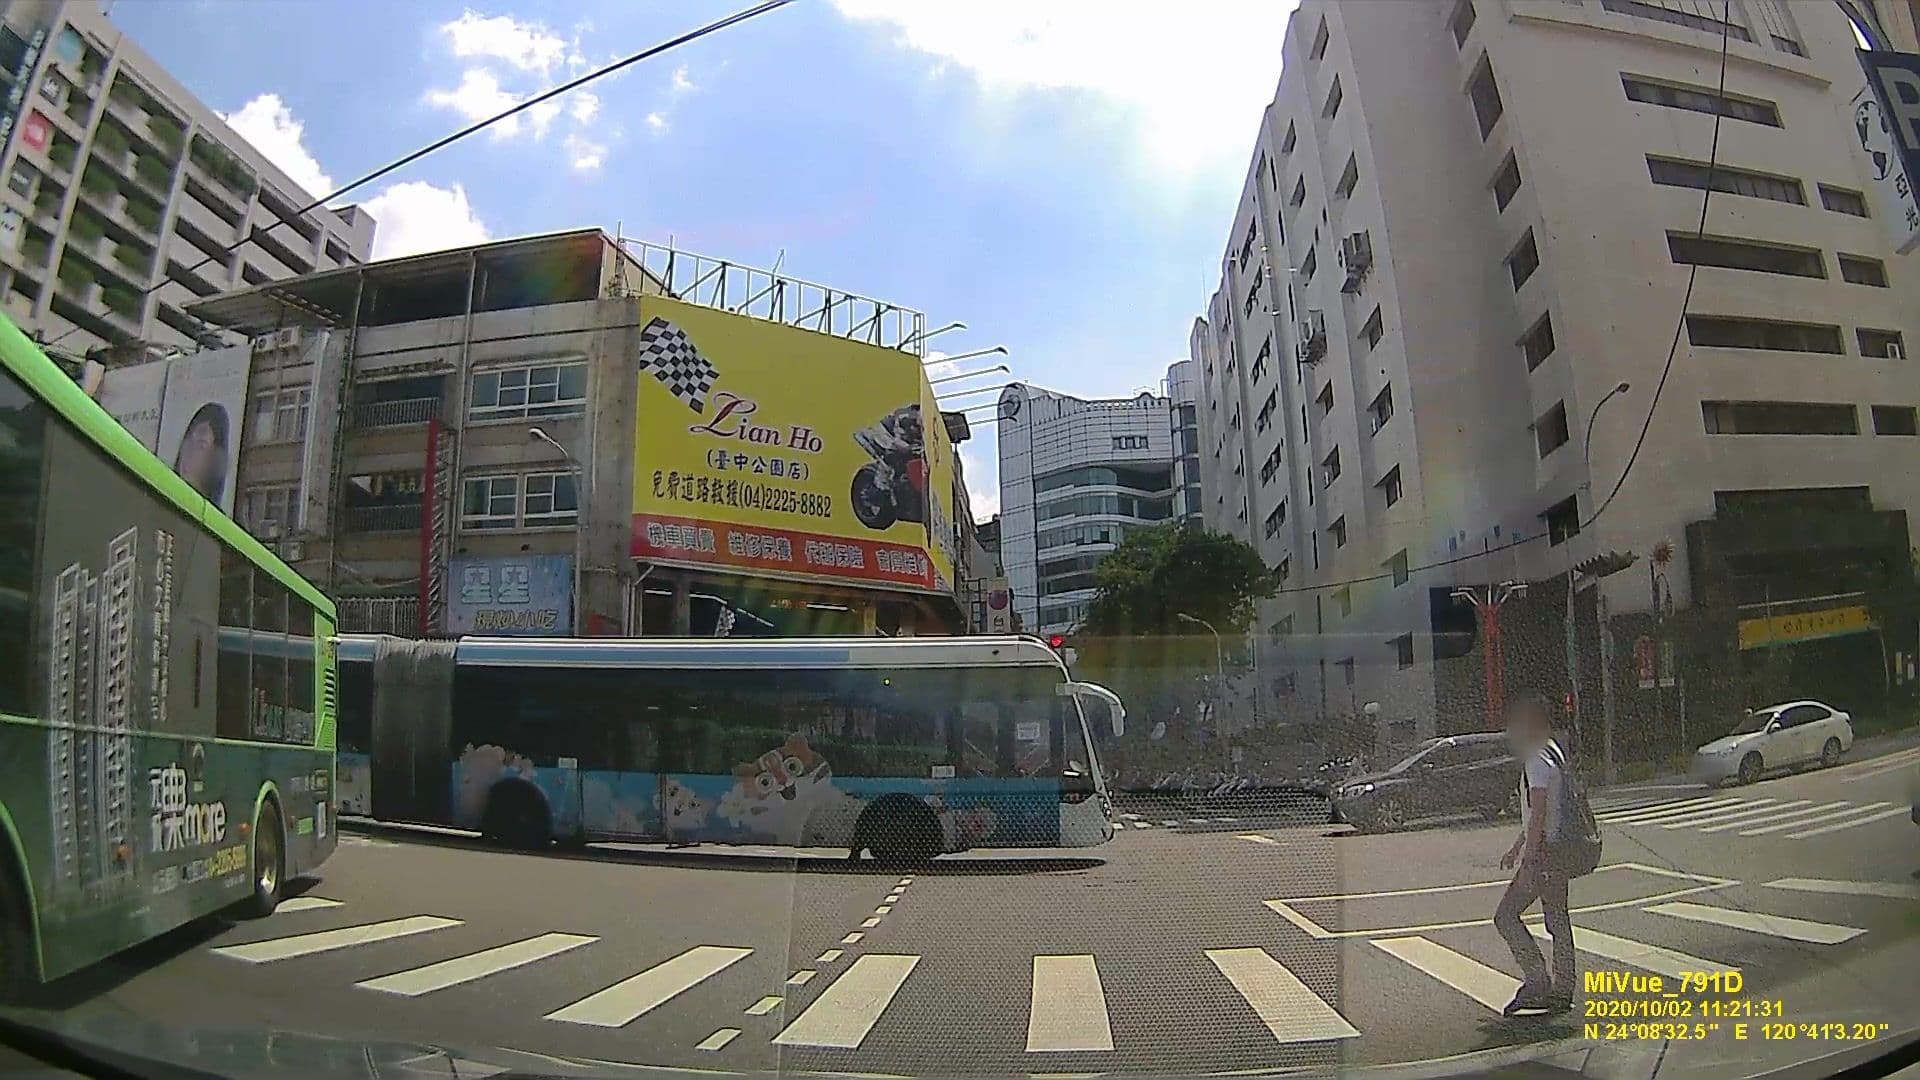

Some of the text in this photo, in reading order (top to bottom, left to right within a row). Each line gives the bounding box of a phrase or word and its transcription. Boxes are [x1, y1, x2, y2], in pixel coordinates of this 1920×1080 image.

[690, 393, 823, 452] Lian Ho
[461, 563, 530, 604] 星星
